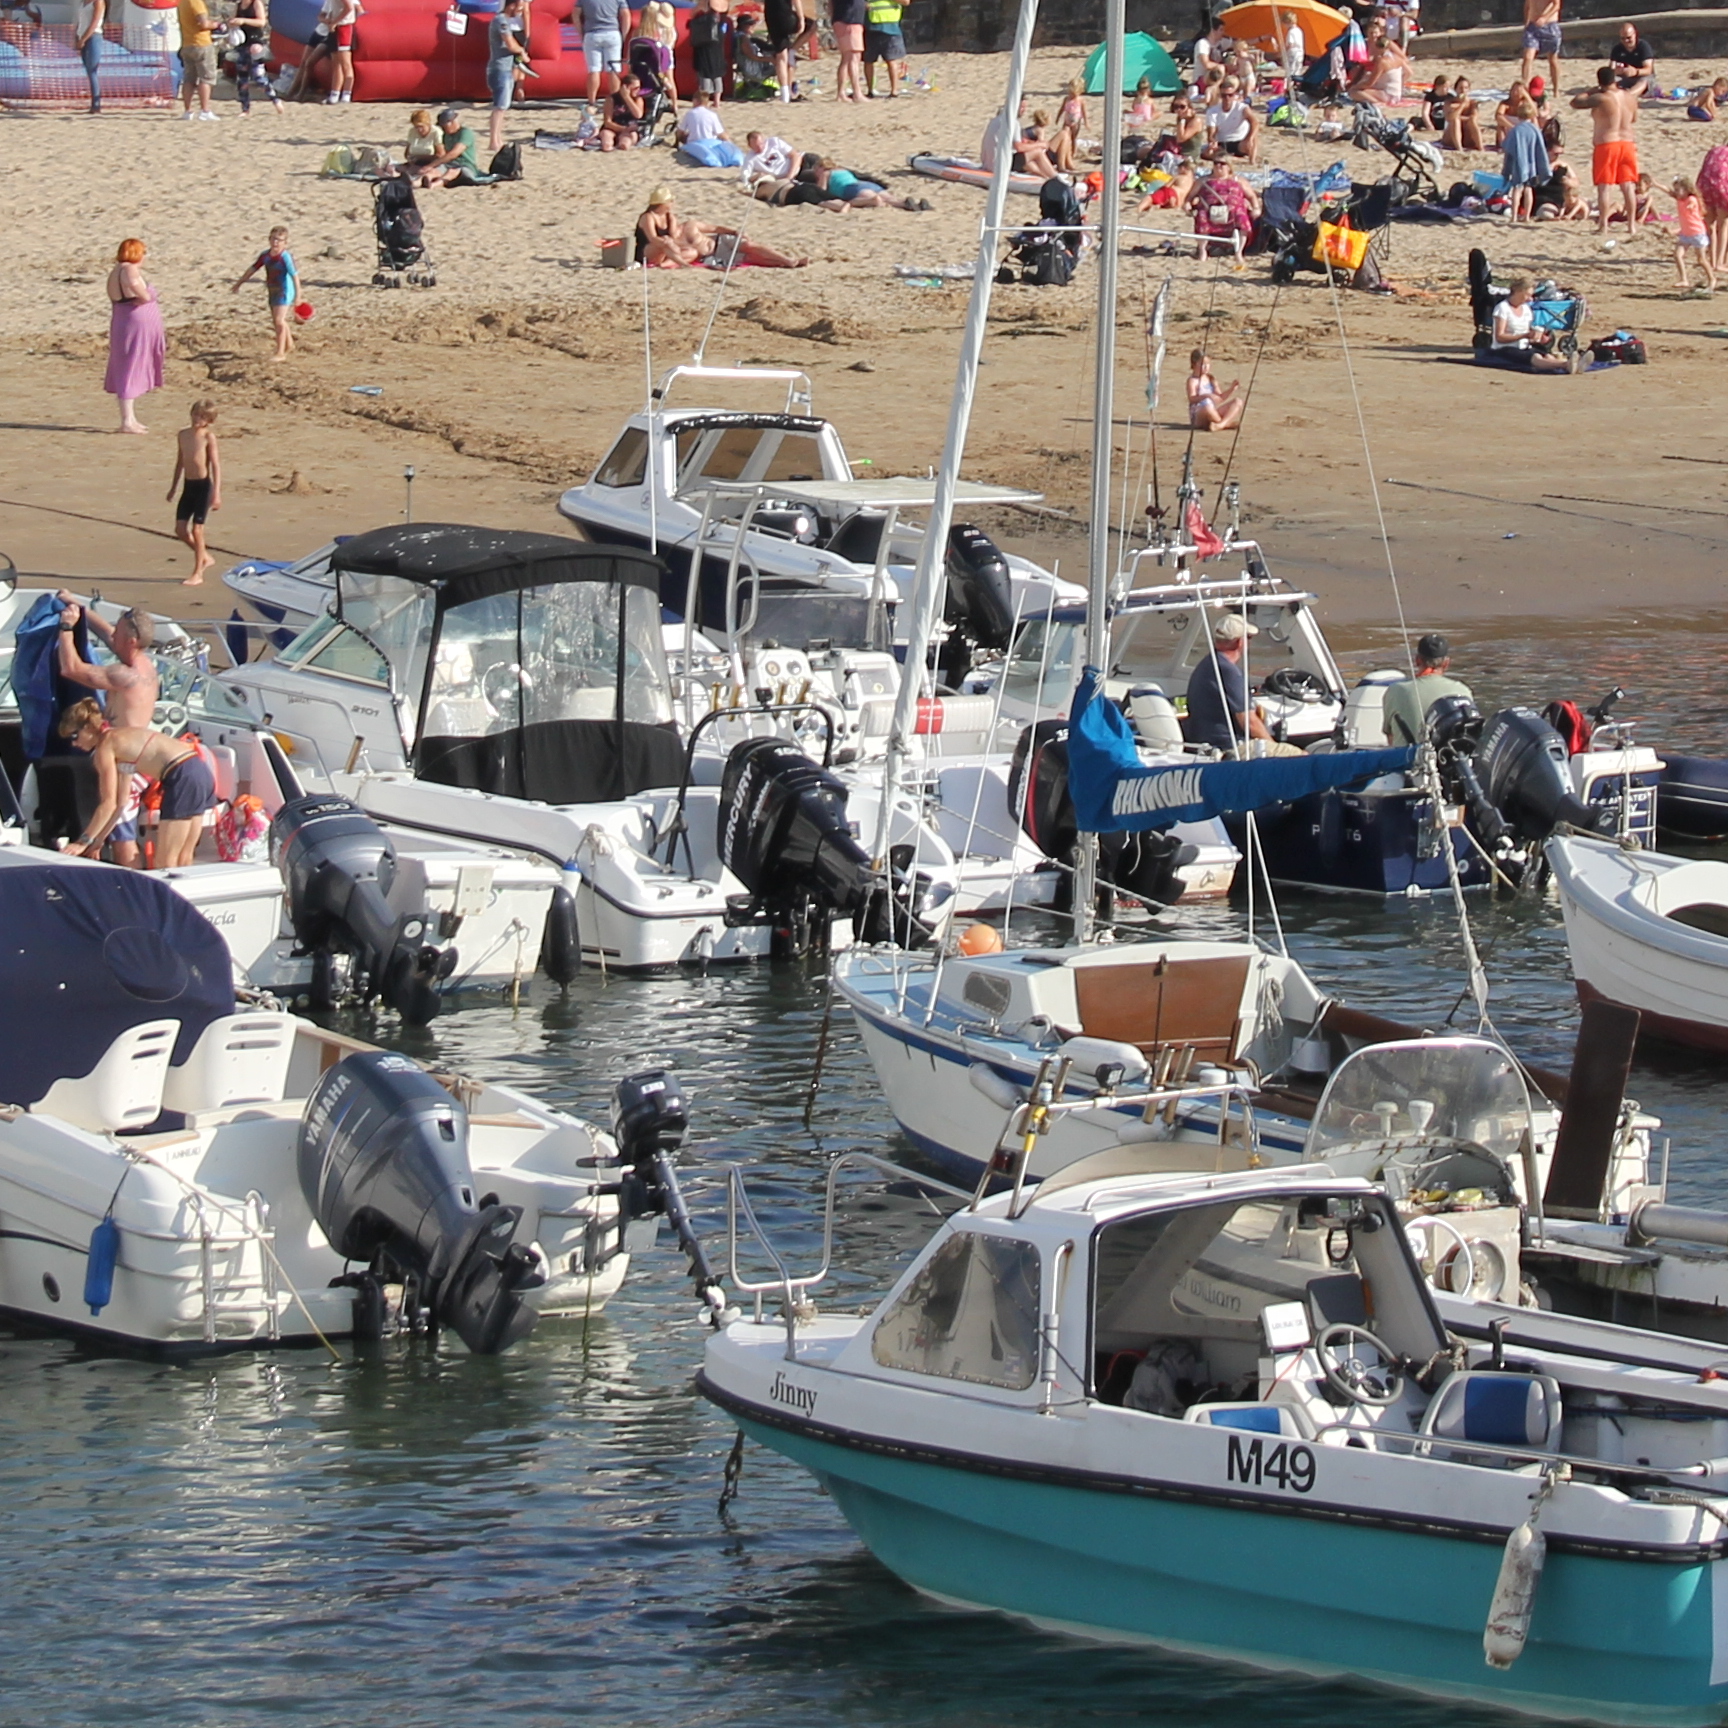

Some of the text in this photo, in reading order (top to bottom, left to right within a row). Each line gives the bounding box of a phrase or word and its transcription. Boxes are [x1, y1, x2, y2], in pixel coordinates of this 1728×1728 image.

[1481, 721, 1510, 763] YAMAHA
[724, 761, 754, 867] MERCURY
[1112, 767, 1204, 816] BALMORAL
[305, 1073, 352, 1146] YAMAHA
[769, 1371, 818, 1418] Jinny
[1227, 1434, 1317, 1493] M49
